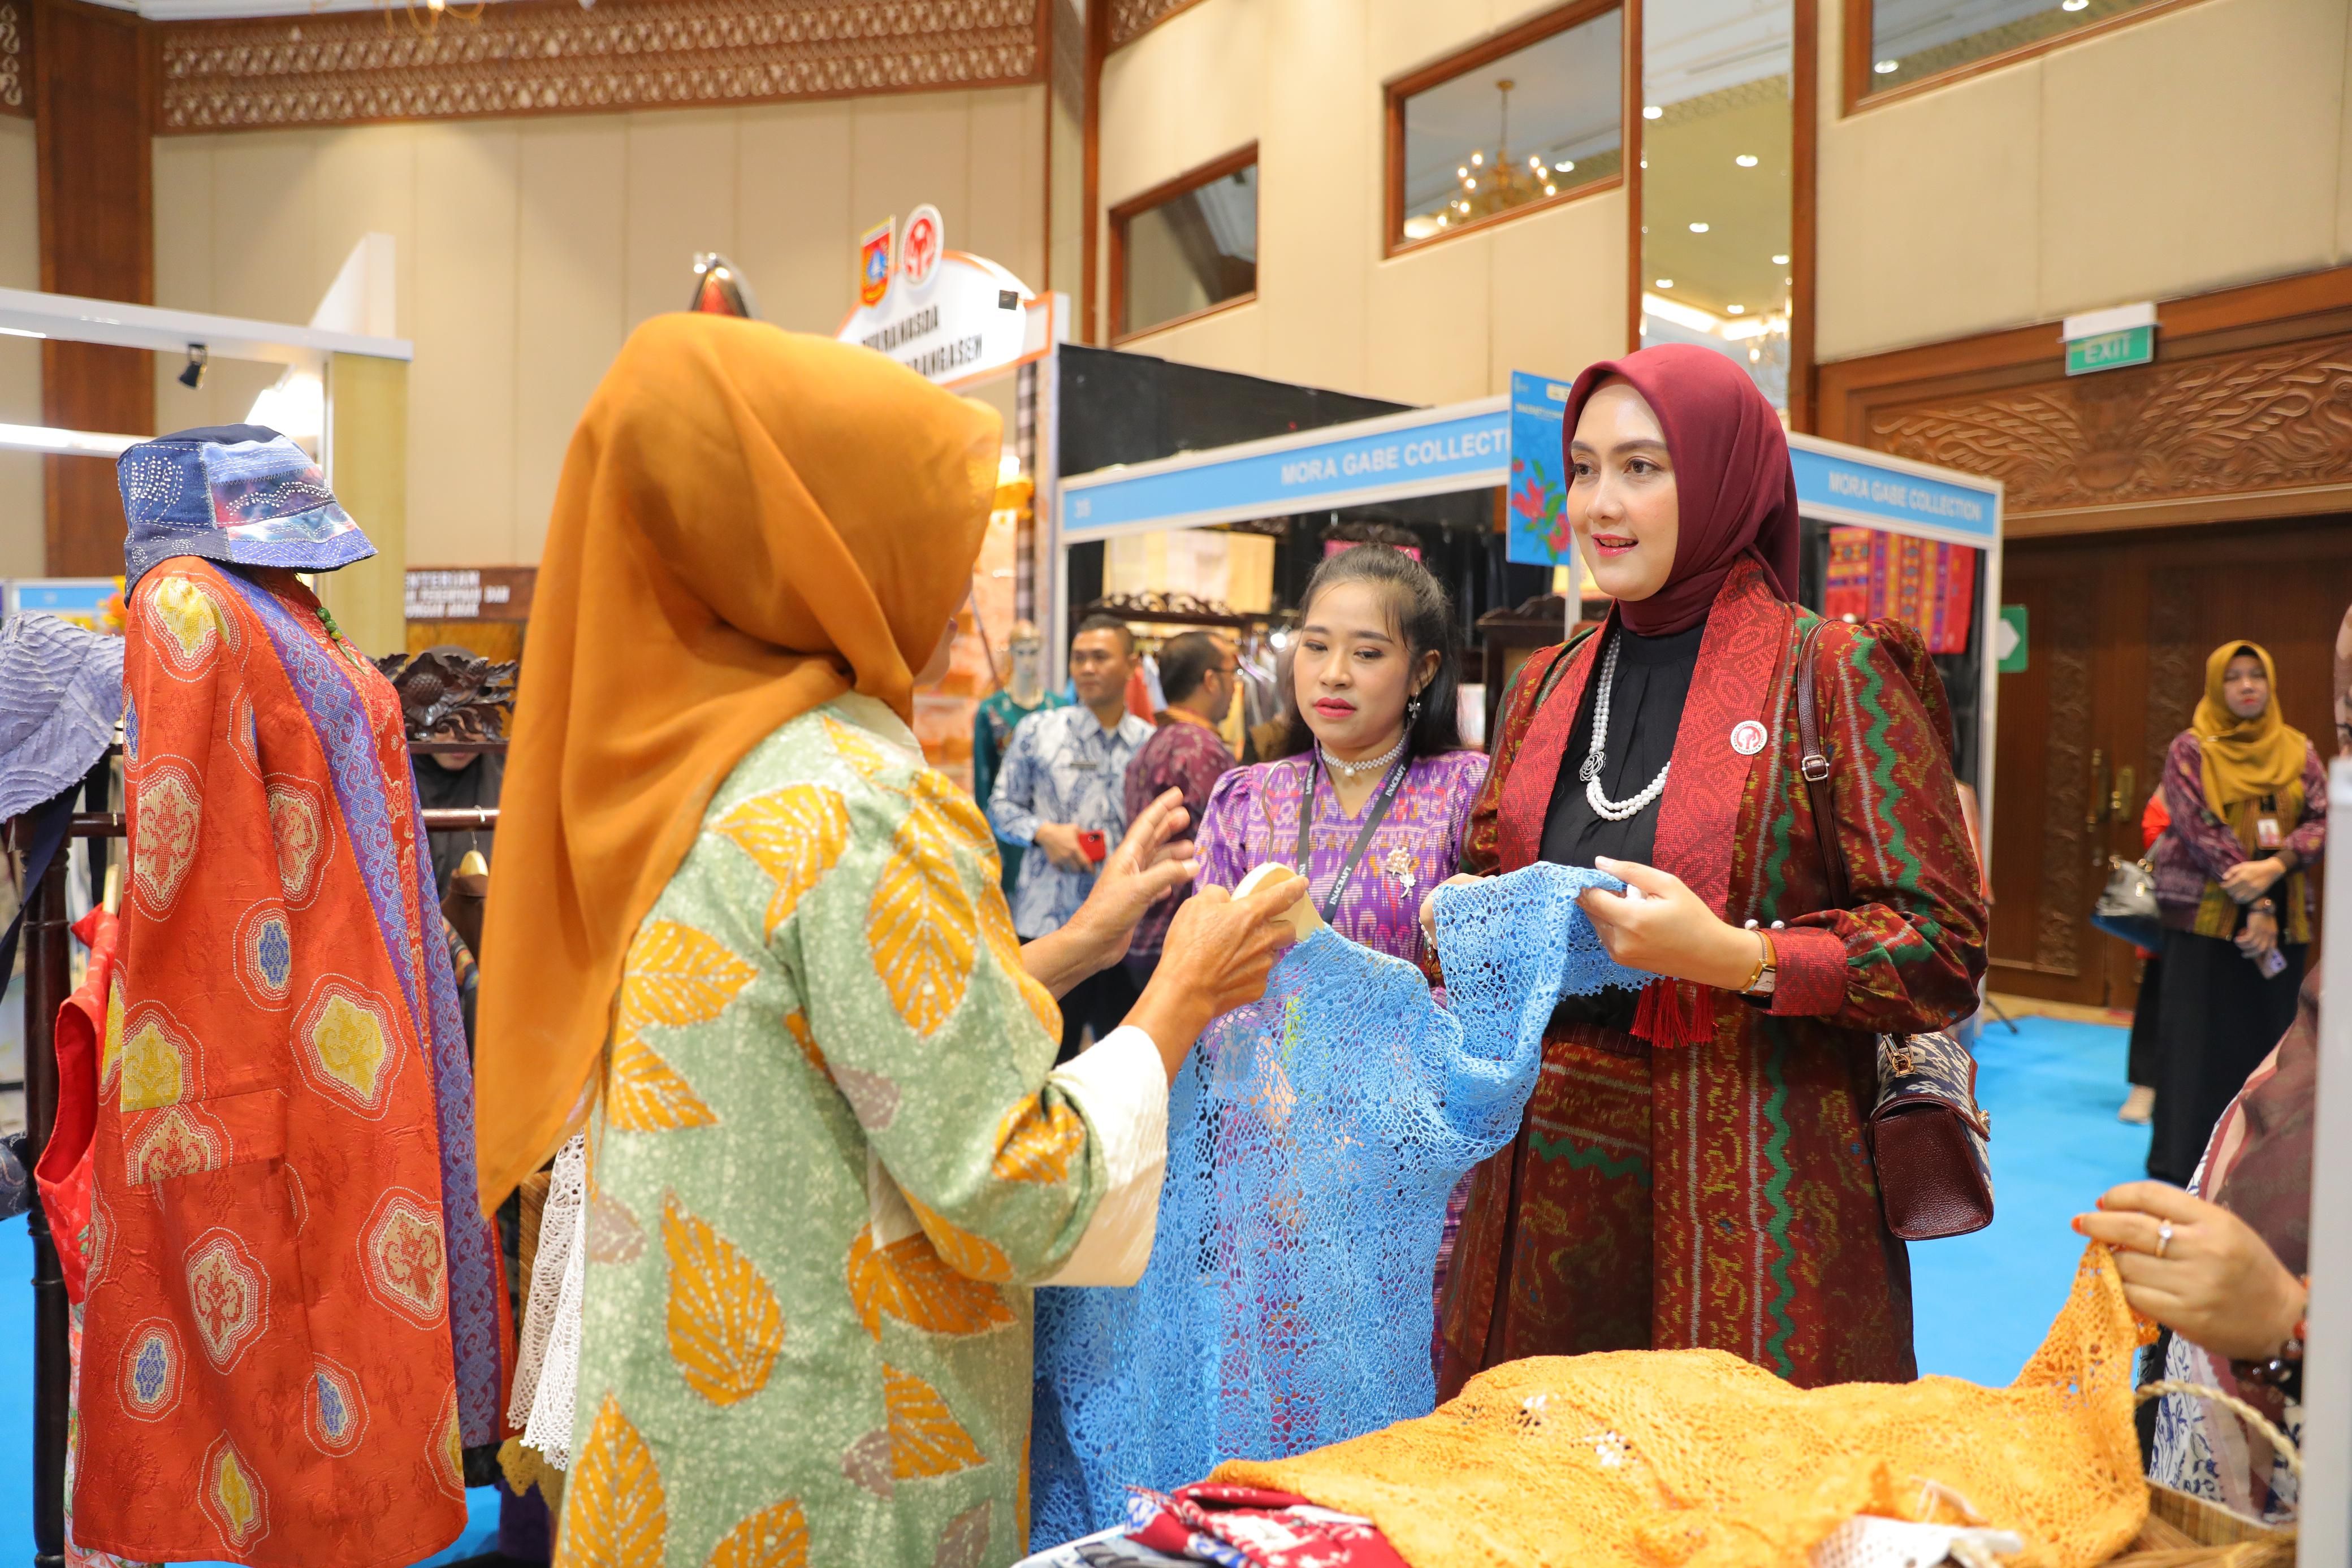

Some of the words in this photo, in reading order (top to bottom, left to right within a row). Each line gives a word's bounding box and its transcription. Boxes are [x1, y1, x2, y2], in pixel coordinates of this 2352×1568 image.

[2084, 332, 2131, 363] EXIT
[1281, 456, 1338, 485] MORA
[1342, 445, 1399, 476] GABE
[1829, 471, 1869, 499] MORA
[1871, 481, 1906, 508] GABE
[1909, 488, 1982, 521] COLLECTION
[1385, 764, 1407, 797] INACRAFT
[1329, 865, 1352, 906] INACRAFT
